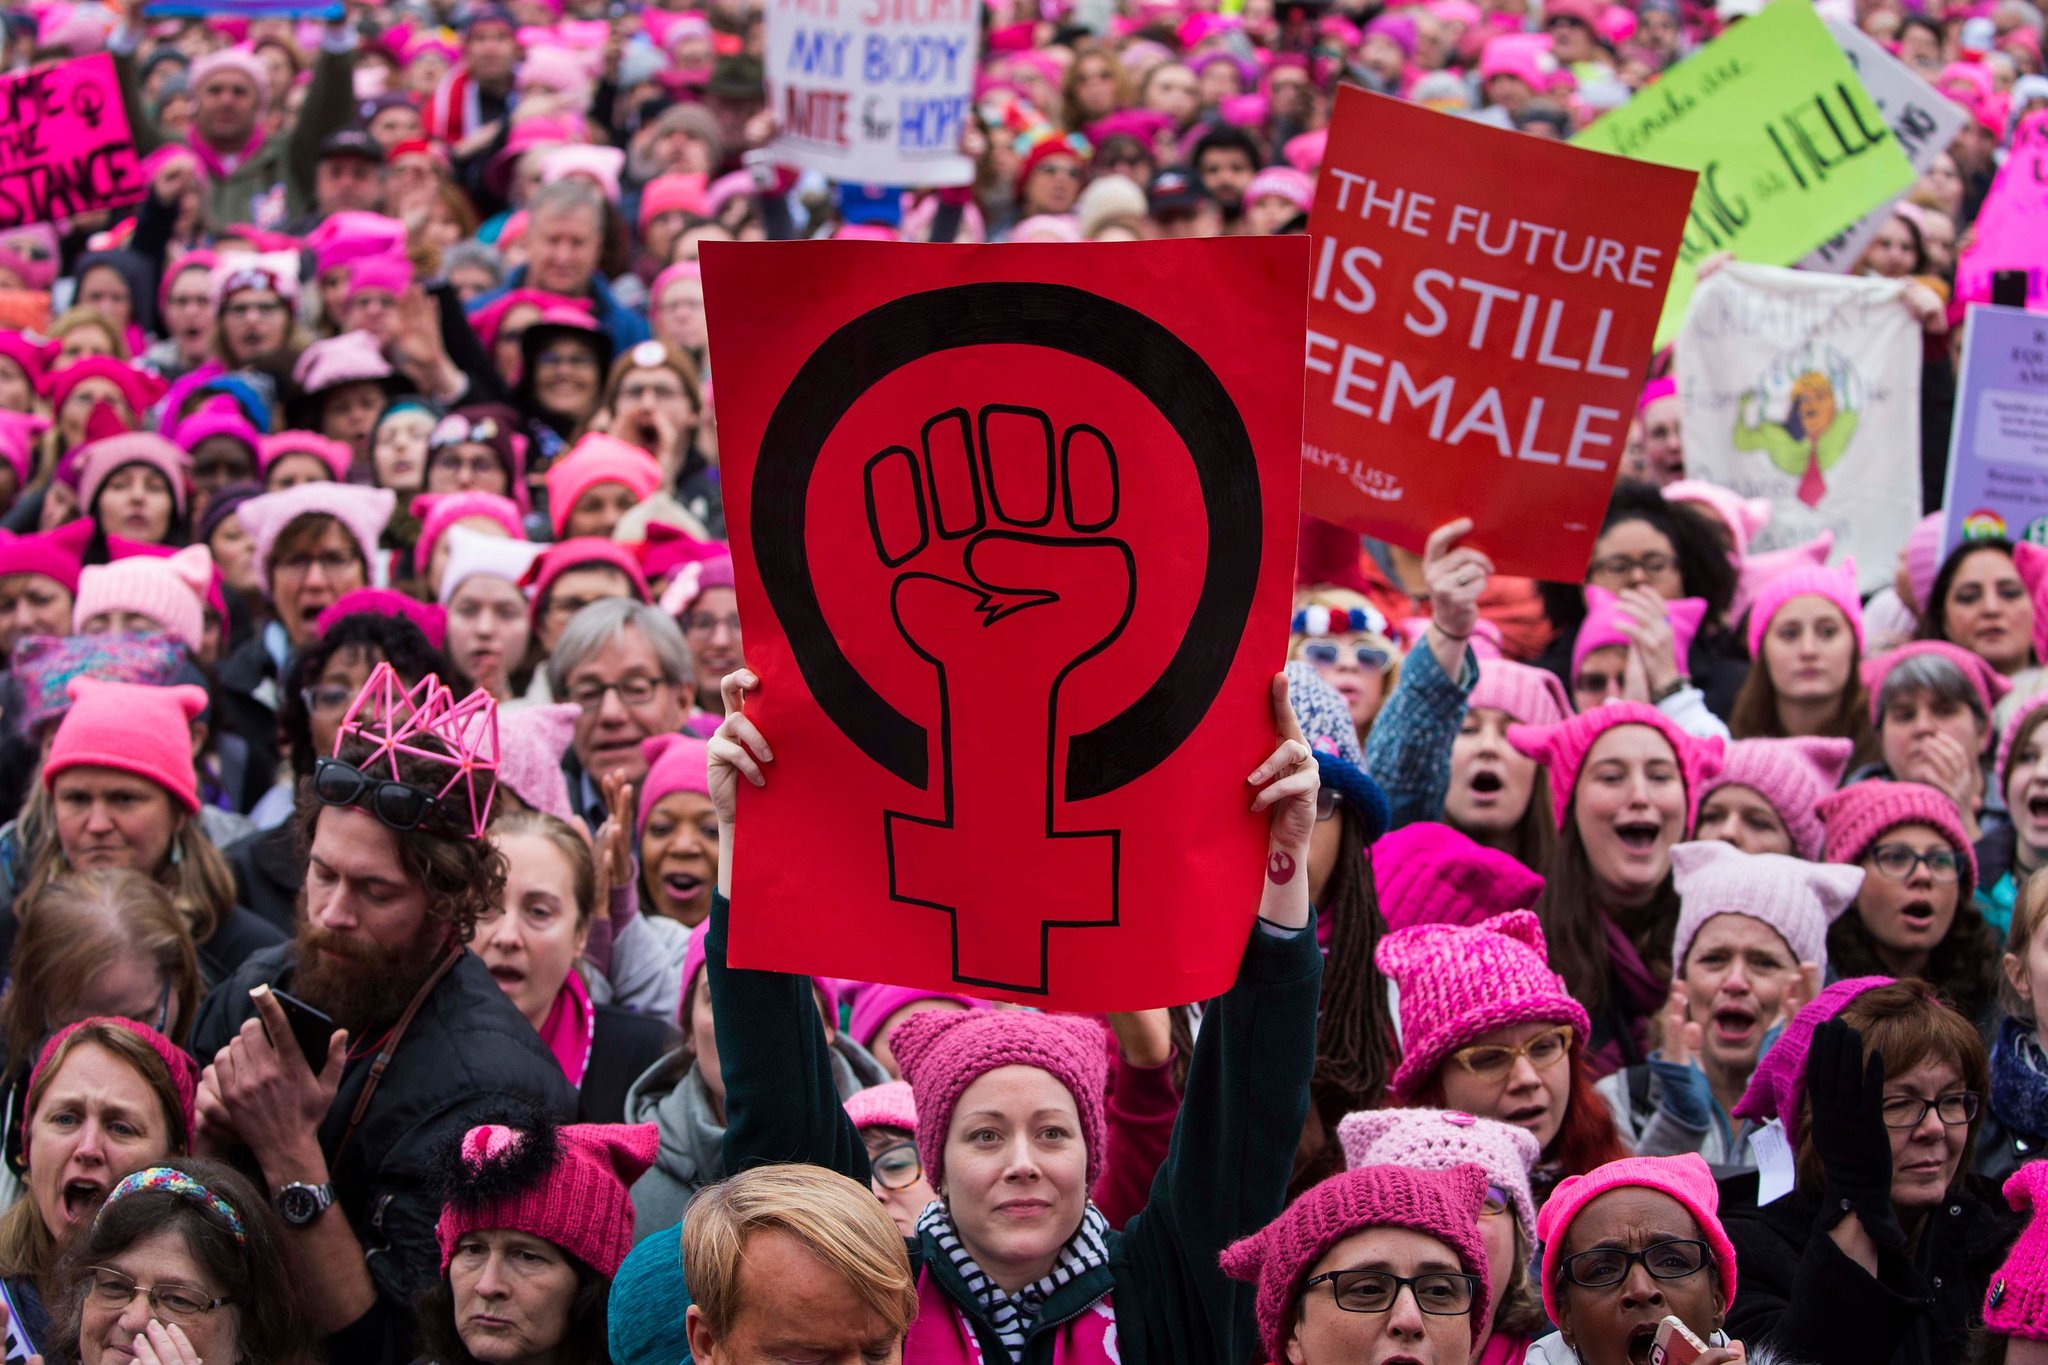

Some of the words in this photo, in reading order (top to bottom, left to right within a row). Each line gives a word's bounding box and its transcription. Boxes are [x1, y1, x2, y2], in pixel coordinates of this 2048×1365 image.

[787, 28, 850, 80] MY
[862, 32, 968, 85] BODY
[1764, 79, 1889, 191] HELL
[1330, 167, 1437, 238] THE
[1446, 203, 1662, 289] FUTURE
[1311, 235, 1384, 315] IS
[1403, 267, 1631, 380] STILL
[1304, 329, 1622, 472] FEMALE
[1352, 459, 1400, 491] LIST
